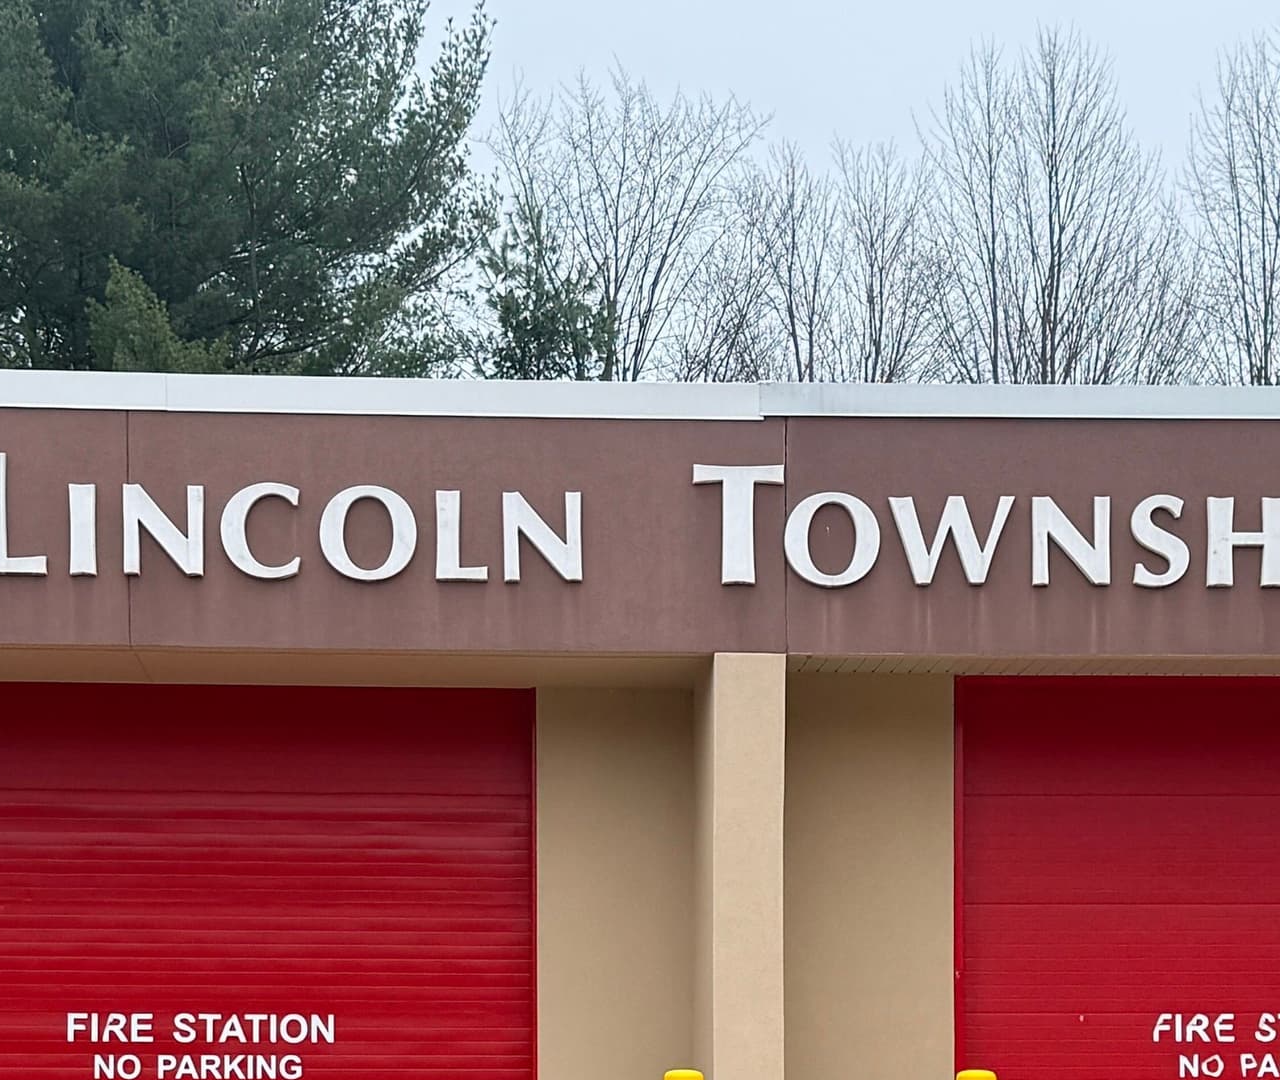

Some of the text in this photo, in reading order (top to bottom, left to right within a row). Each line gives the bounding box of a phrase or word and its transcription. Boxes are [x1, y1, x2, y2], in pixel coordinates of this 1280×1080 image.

[66, 1012, 335, 1044] FIRE STATION
[1152, 1013, 1236, 1042] FIRE
[94, 1054, 303, 1080] NO PARKING
[1179, 1053, 1225, 1078] NO
